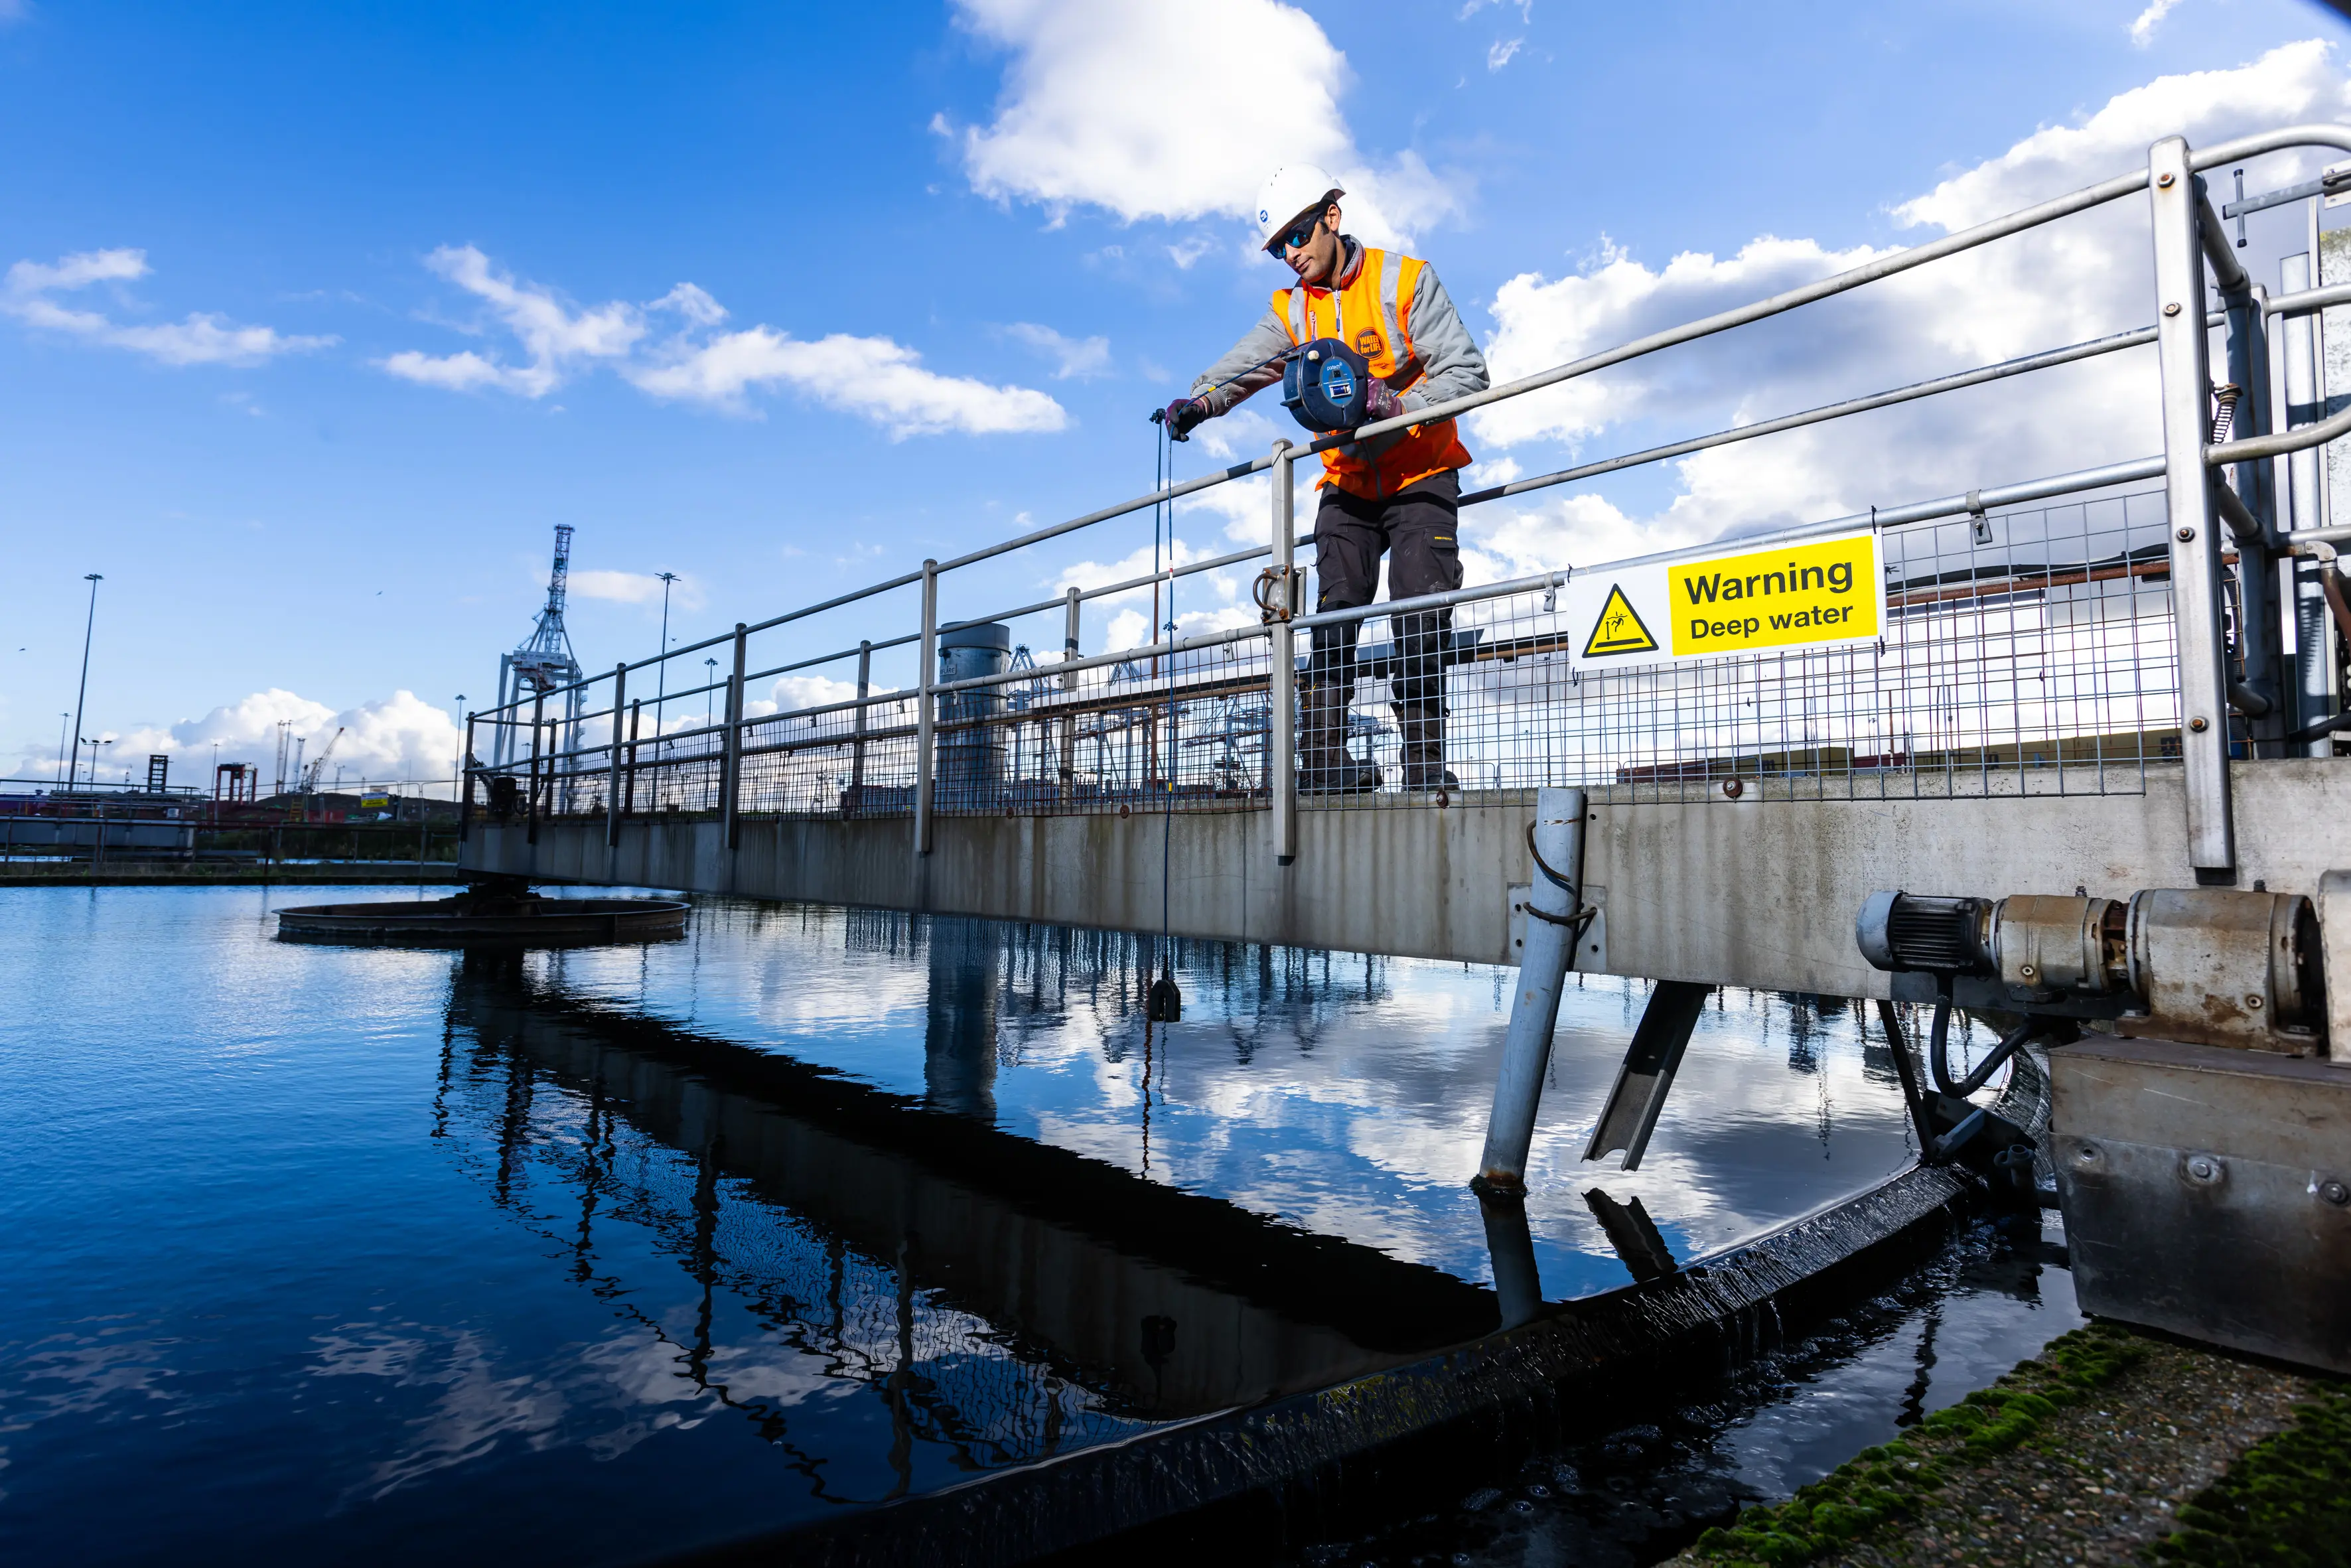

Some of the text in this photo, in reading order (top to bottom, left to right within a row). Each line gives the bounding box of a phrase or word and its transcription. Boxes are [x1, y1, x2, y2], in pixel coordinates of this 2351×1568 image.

[1359, 334, 1380, 345] WATER
[1360, 345, 1370, 354] for
[1684, 562, 1853, 605] Warning
[1691, 605, 1853, 639] Deep water
